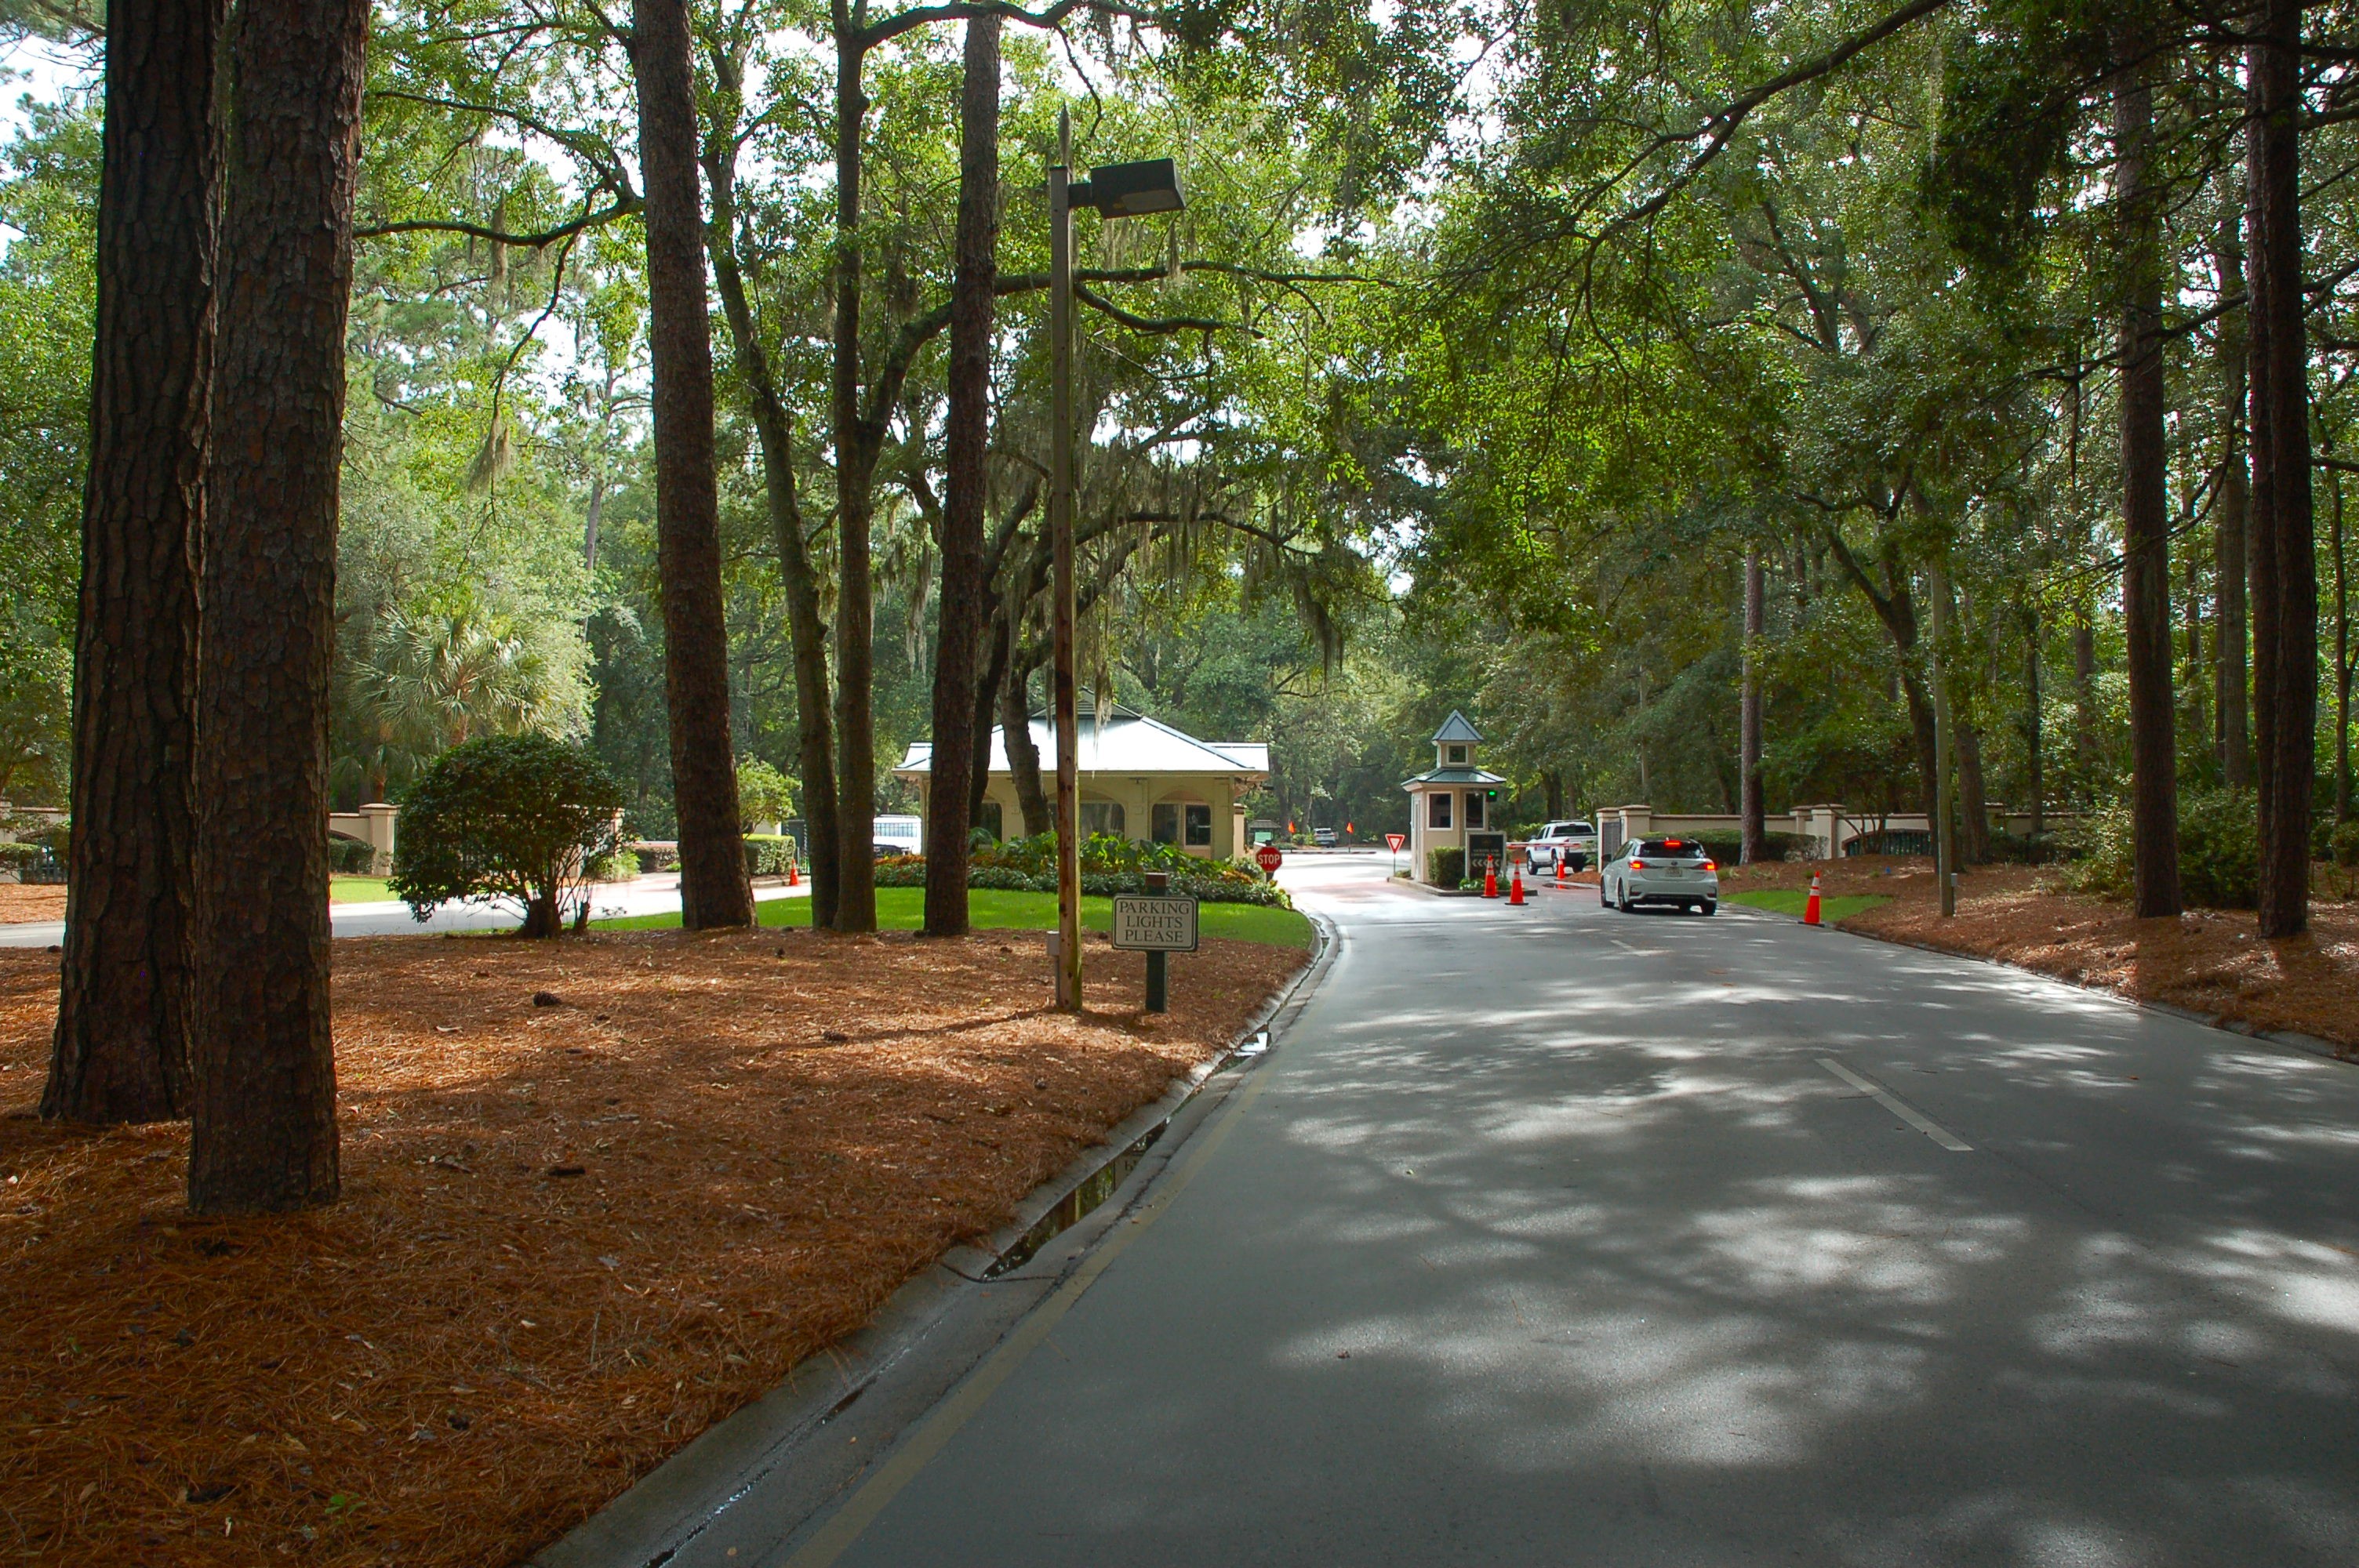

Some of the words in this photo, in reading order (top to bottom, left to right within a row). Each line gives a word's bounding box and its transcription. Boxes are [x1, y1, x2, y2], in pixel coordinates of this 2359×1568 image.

[1258, 855, 1280, 864] STOP
[1119, 901, 1190, 915] PARKING
[1126, 915, 1183, 928] LIGHTS
[1125, 929, 1183, 942] PLEASE
